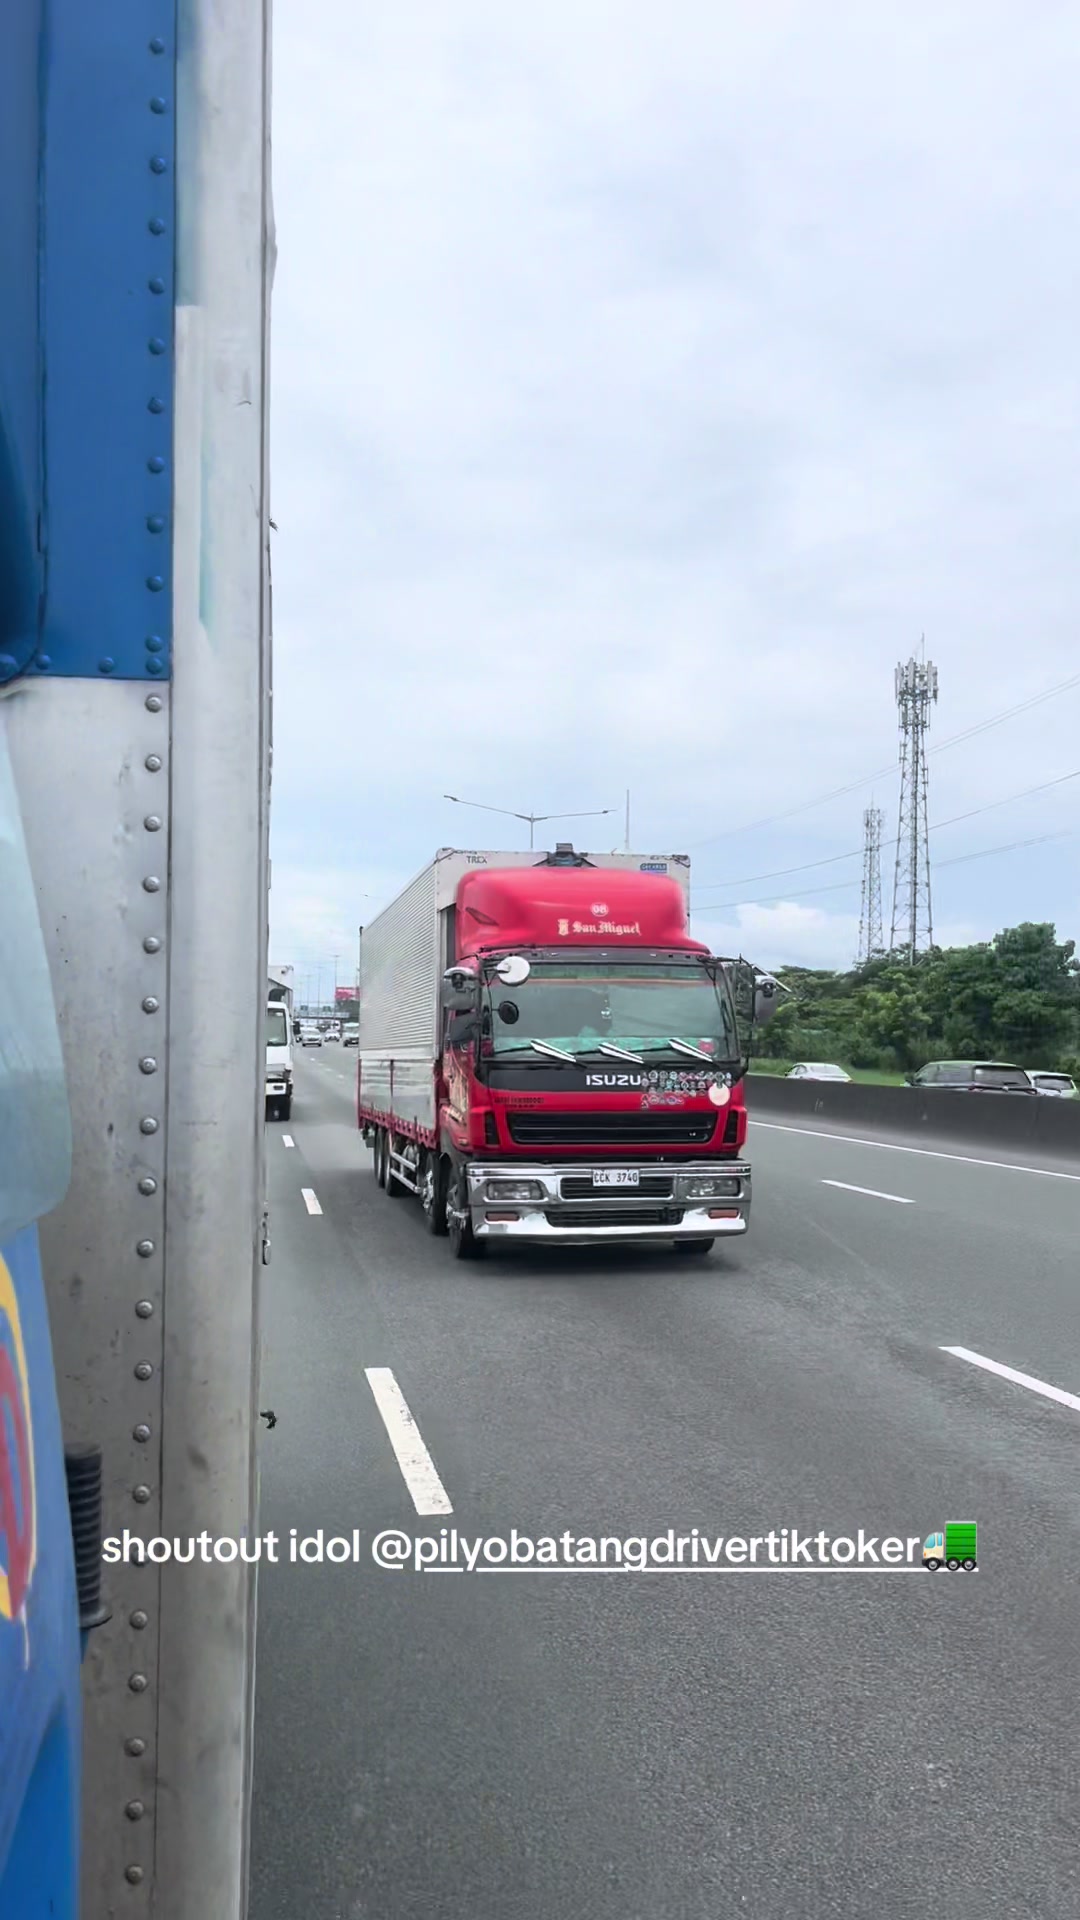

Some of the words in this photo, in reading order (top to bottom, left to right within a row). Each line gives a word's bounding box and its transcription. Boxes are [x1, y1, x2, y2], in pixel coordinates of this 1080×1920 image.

[572, 920, 597, 934] San
[597, 920, 642, 936] Miguel
[585, 1074, 642, 1086] ISUZU
[616, 1172, 638, 1183] 3740
